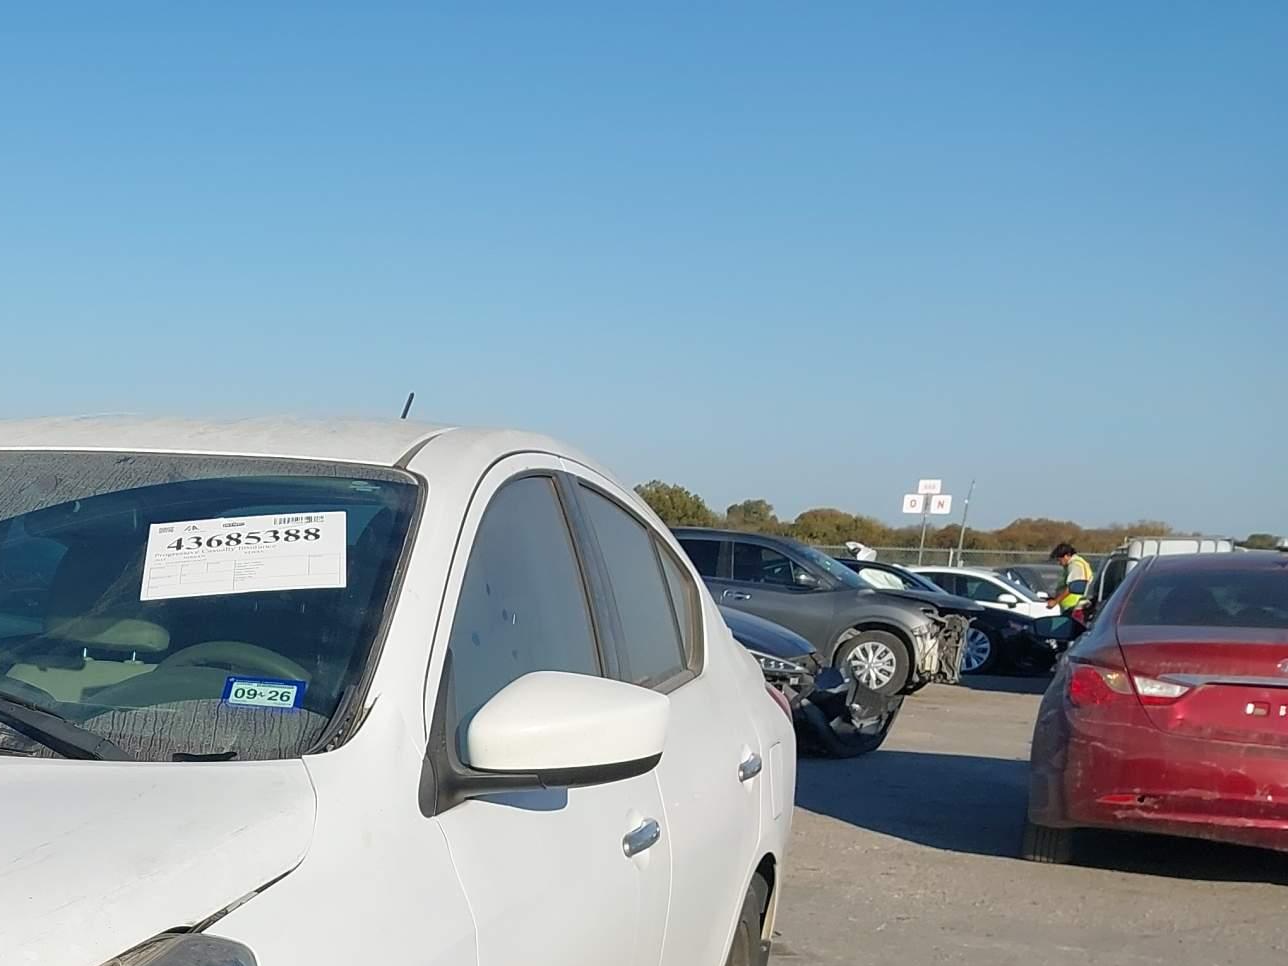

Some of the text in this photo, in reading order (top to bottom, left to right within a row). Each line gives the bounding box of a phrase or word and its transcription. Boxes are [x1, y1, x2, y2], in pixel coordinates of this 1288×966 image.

[167, 527, 321, 551] 43685388
[233, 687, 291, 702] 09 26
